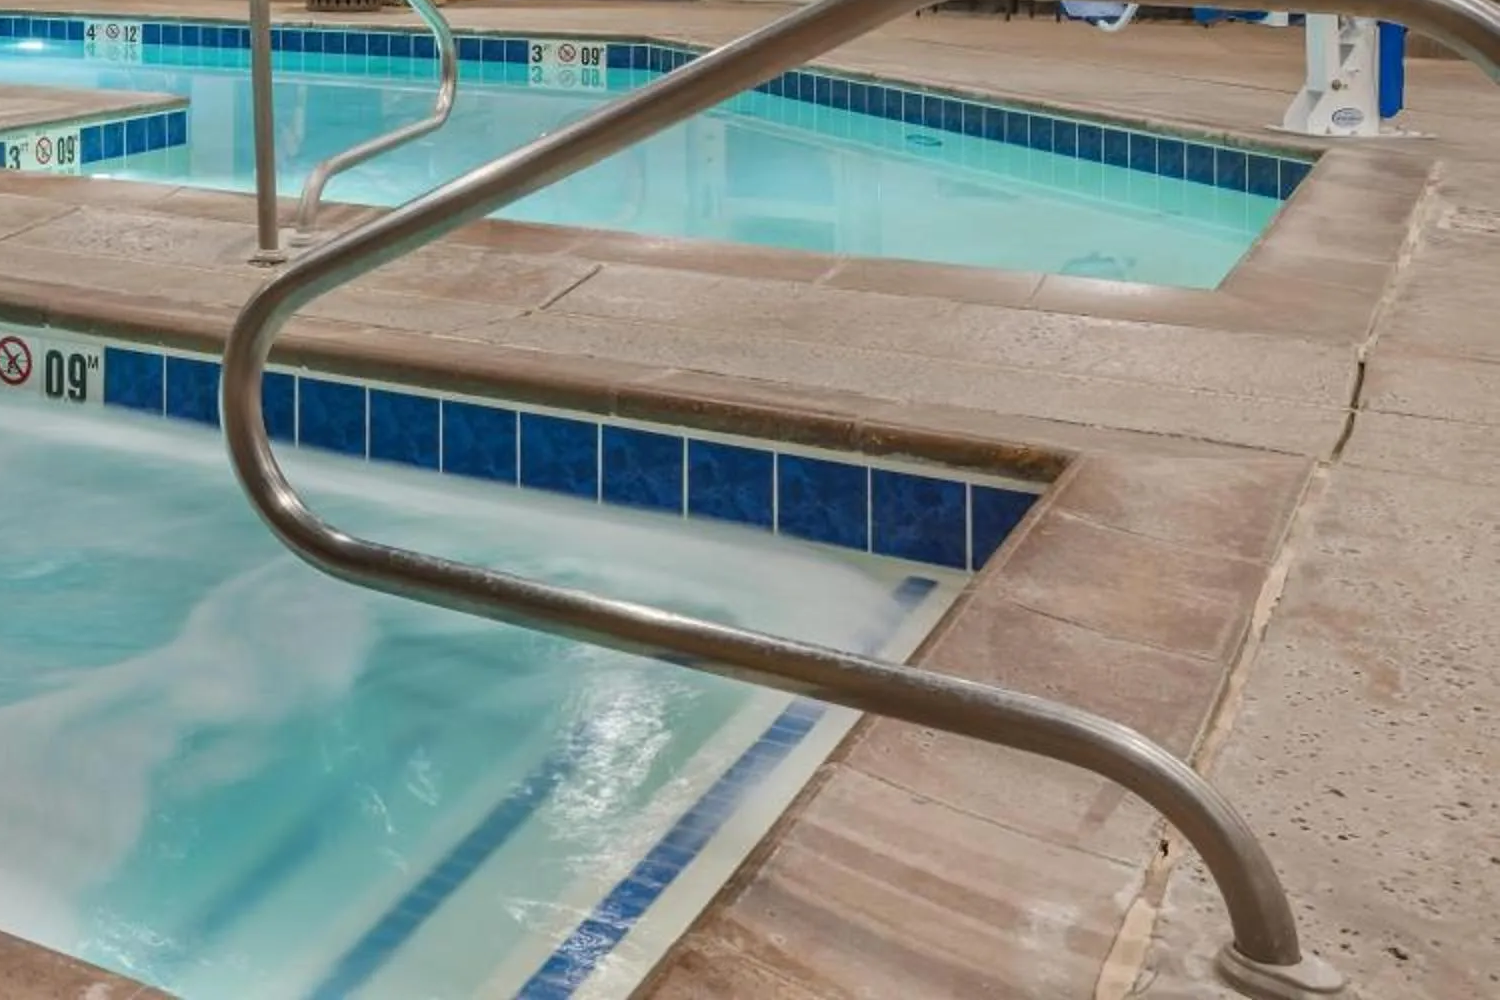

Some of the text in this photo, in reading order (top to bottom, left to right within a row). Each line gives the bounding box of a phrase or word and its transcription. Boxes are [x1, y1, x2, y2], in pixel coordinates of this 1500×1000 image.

[86, 24, 96, 41] 4
[531, 44, 543, 63] 3
[9, 145, 20, 169] 3
